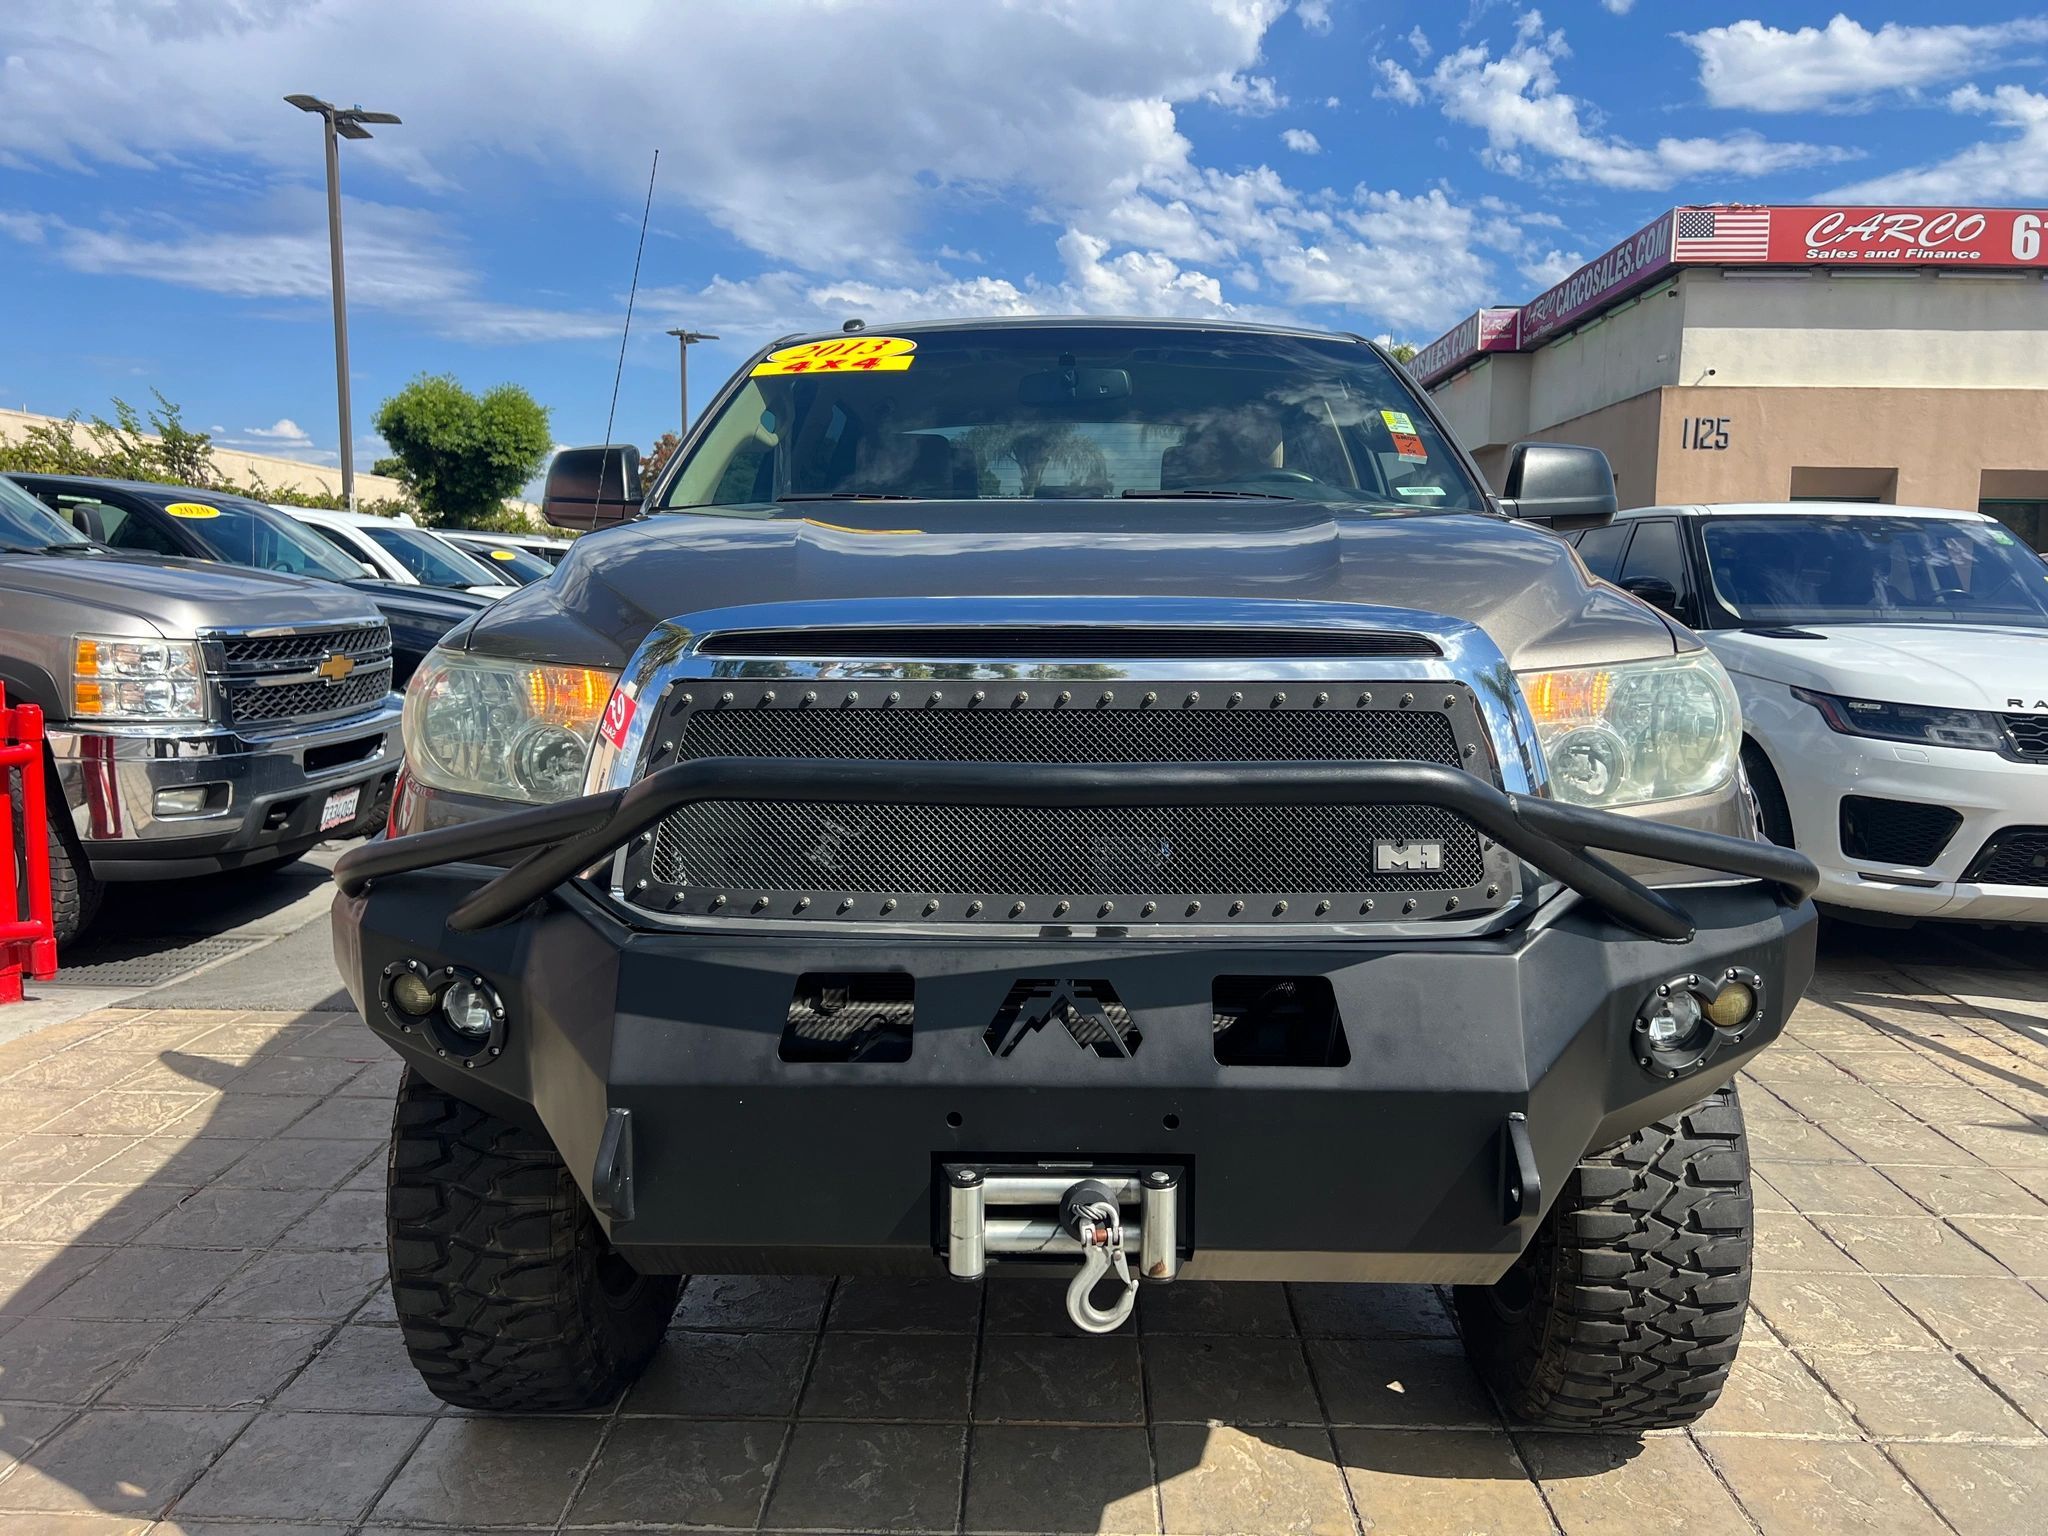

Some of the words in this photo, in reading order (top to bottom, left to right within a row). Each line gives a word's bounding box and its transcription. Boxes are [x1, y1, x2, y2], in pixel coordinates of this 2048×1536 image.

[1805, 212, 1986, 247] CARCO
[1555, 218, 1669, 317] CARCOSALES.COM
[1806, 249, 1858, 259] Sales
[1864, 249, 1900, 259] and
[1905, 249, 1981, 259] Finance
[1524, 291, 1556, 332] CARCO
[788, 340, 891, 360] 2013
[1682, 417, 1731, 450] 1125
